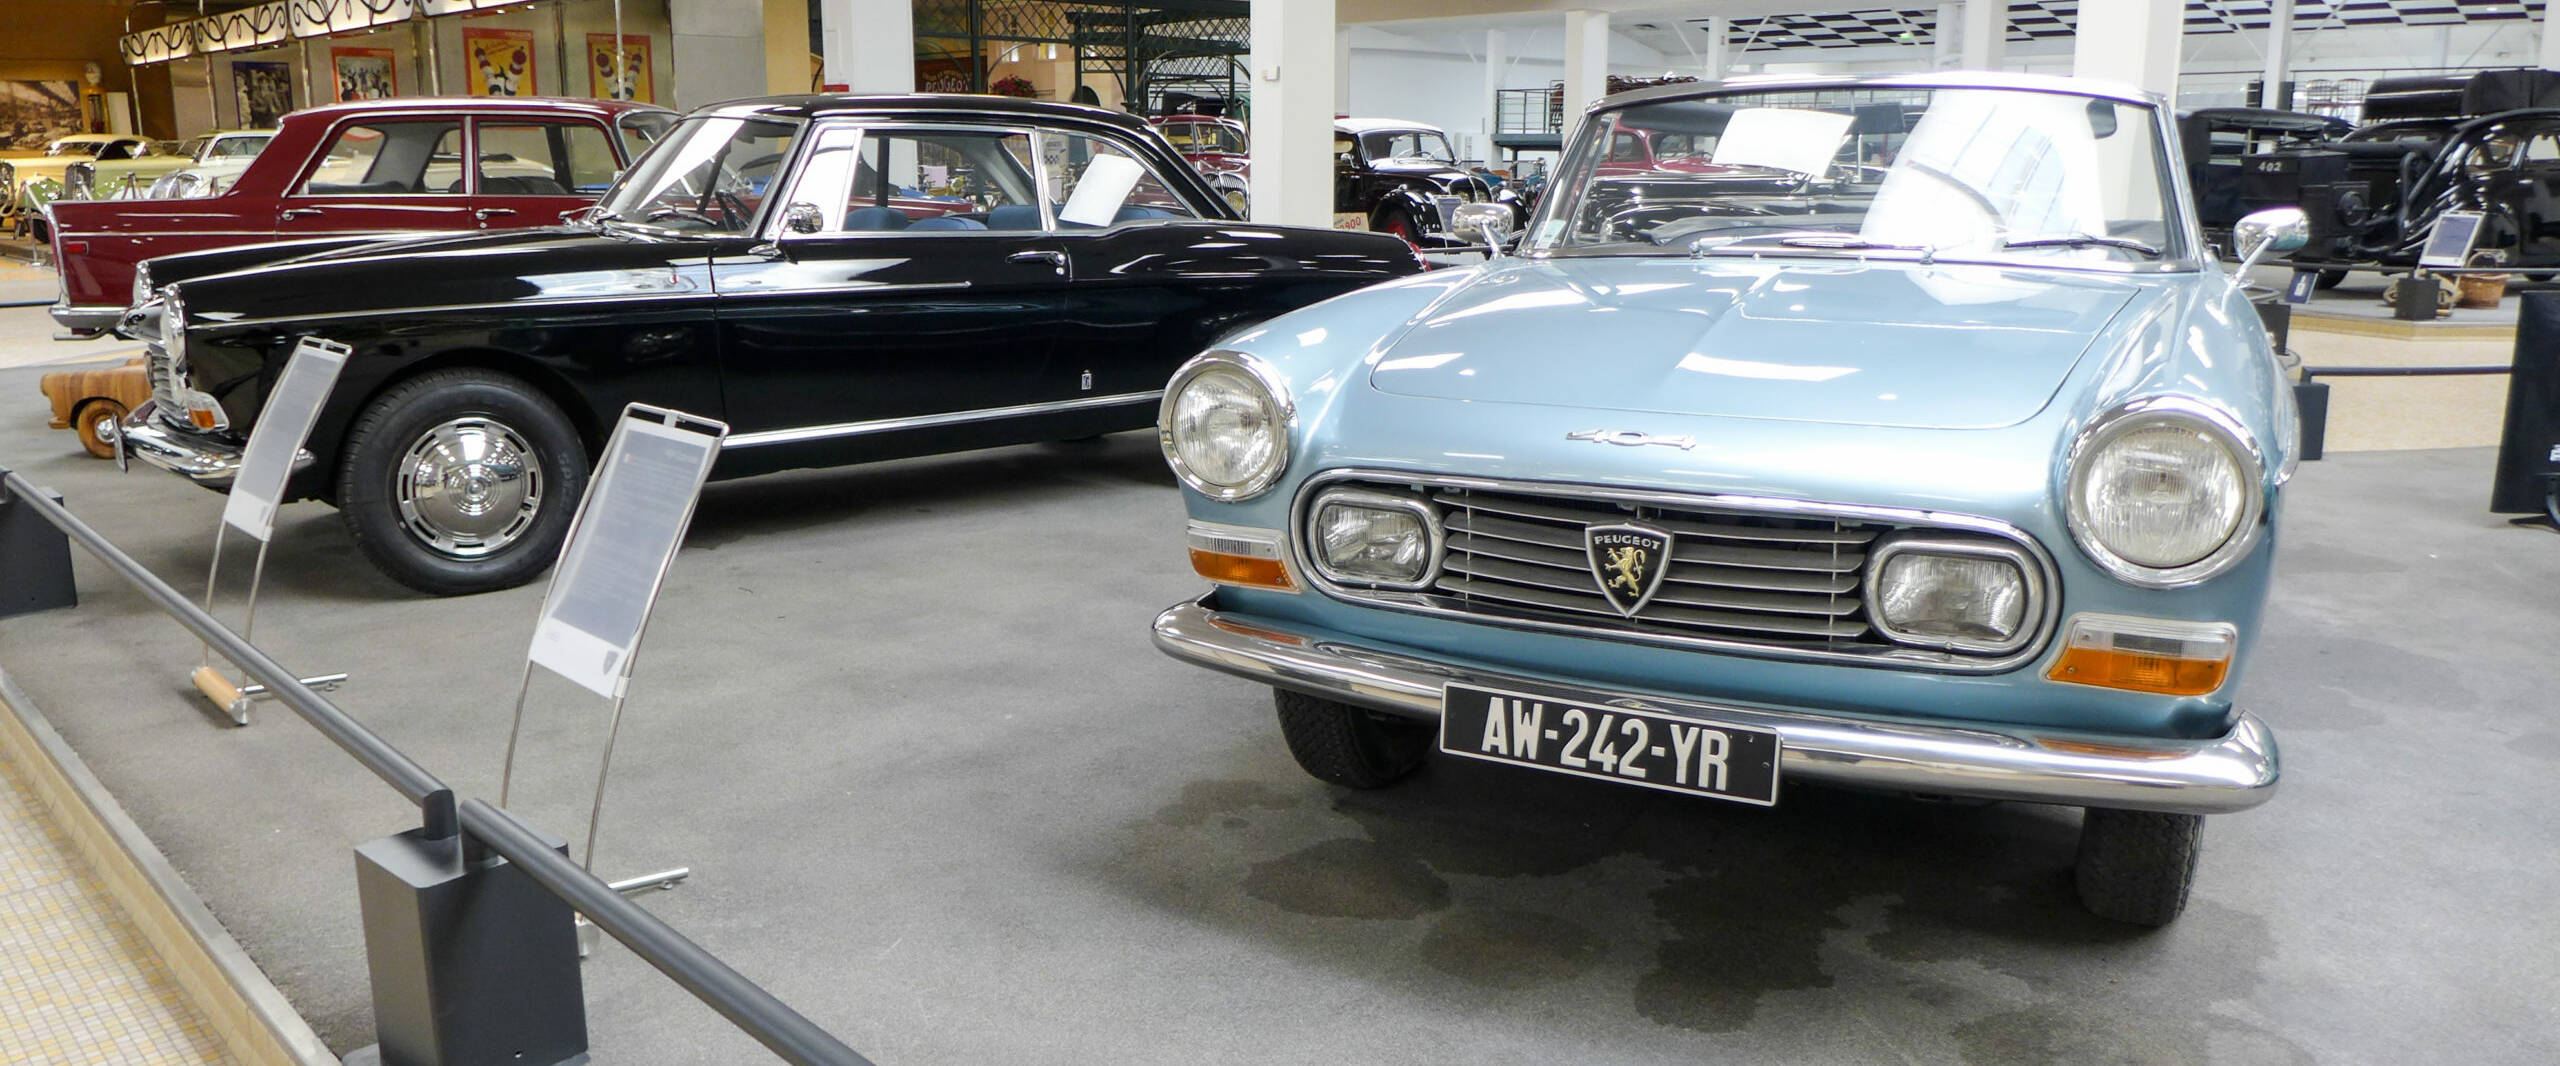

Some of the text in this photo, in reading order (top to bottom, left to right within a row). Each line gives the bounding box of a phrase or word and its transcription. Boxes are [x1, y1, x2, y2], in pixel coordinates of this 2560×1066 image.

[2258, 161, 2282, 172] 402
[1566, 429, 1697, 451] 404
[1594, 535, 1661, 550] PEUGEOT
[1481, 696, 1729, 791] AW-242-YR
